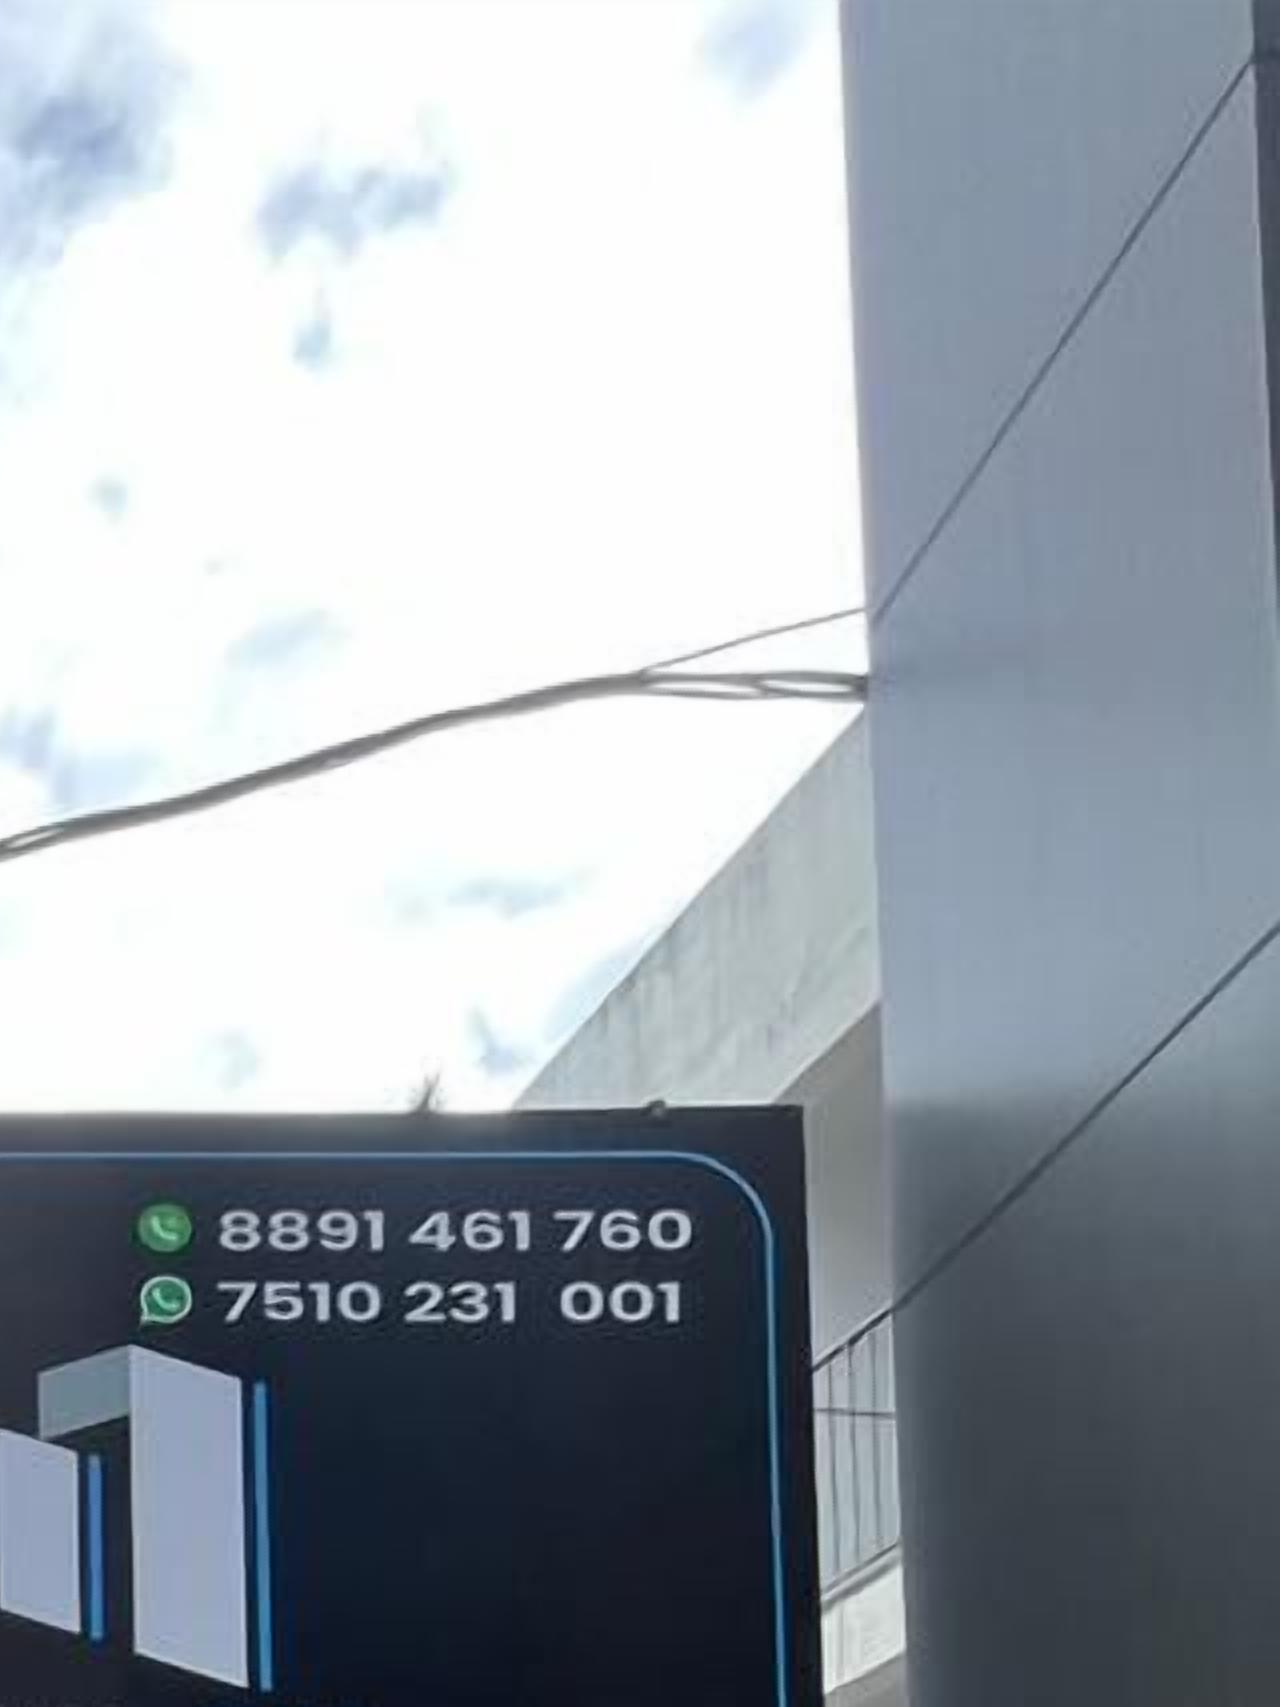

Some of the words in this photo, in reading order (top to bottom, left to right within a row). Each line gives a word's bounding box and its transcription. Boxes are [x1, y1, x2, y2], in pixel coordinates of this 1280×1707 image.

[219, 1210, 385, 1252] 8891
[409, 1210, 531, 1252] 461
[552, 1209, 693, 1252] 760
[216, 1281, 382, 1323] 7510
[403, 1281, 517, 1323] 231
[560, 1281, 682, 1323] 001
